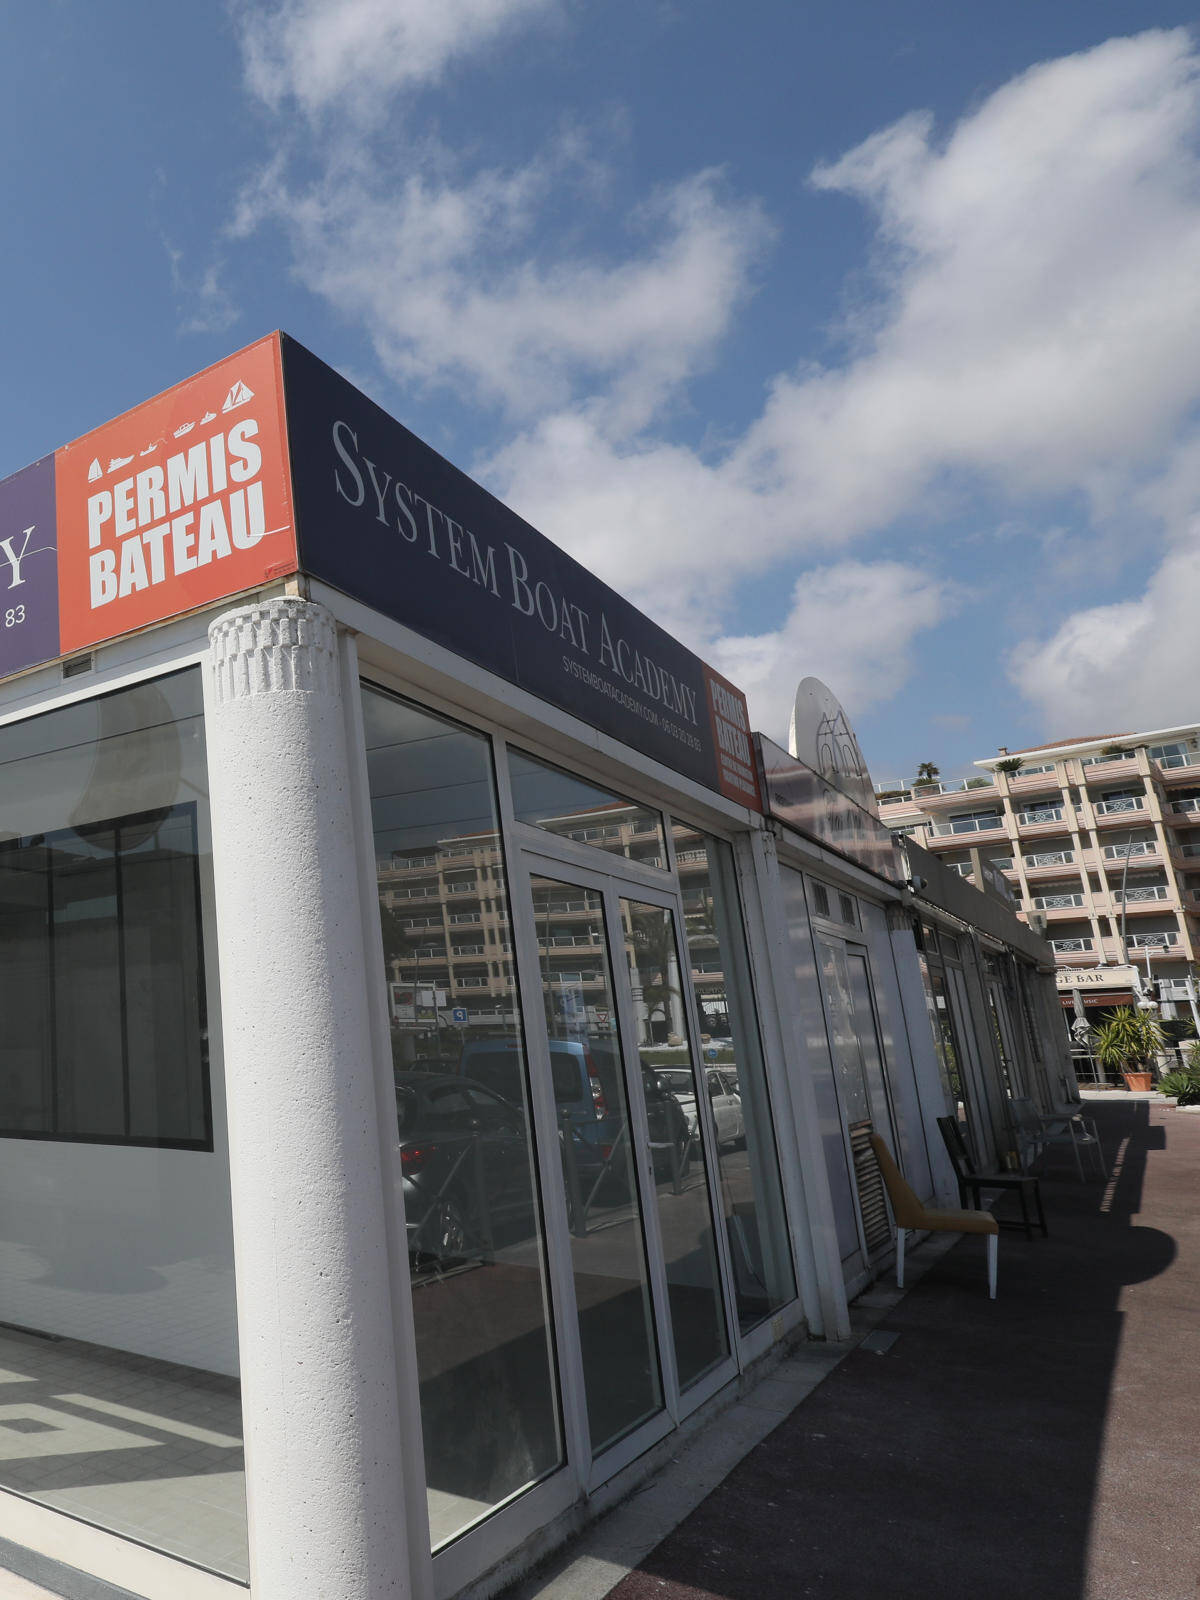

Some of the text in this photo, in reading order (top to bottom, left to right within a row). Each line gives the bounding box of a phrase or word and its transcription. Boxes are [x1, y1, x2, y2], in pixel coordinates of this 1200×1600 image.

[87, 418, 263, 550] PERMIS
[89, 481, 266, 610] BATEAU
[5, 604, 26, 628] 83
[332, 420, 698, 726] SYSTEM BOAT ACADEMY
[1076, 974, 1104, 983] BAR
